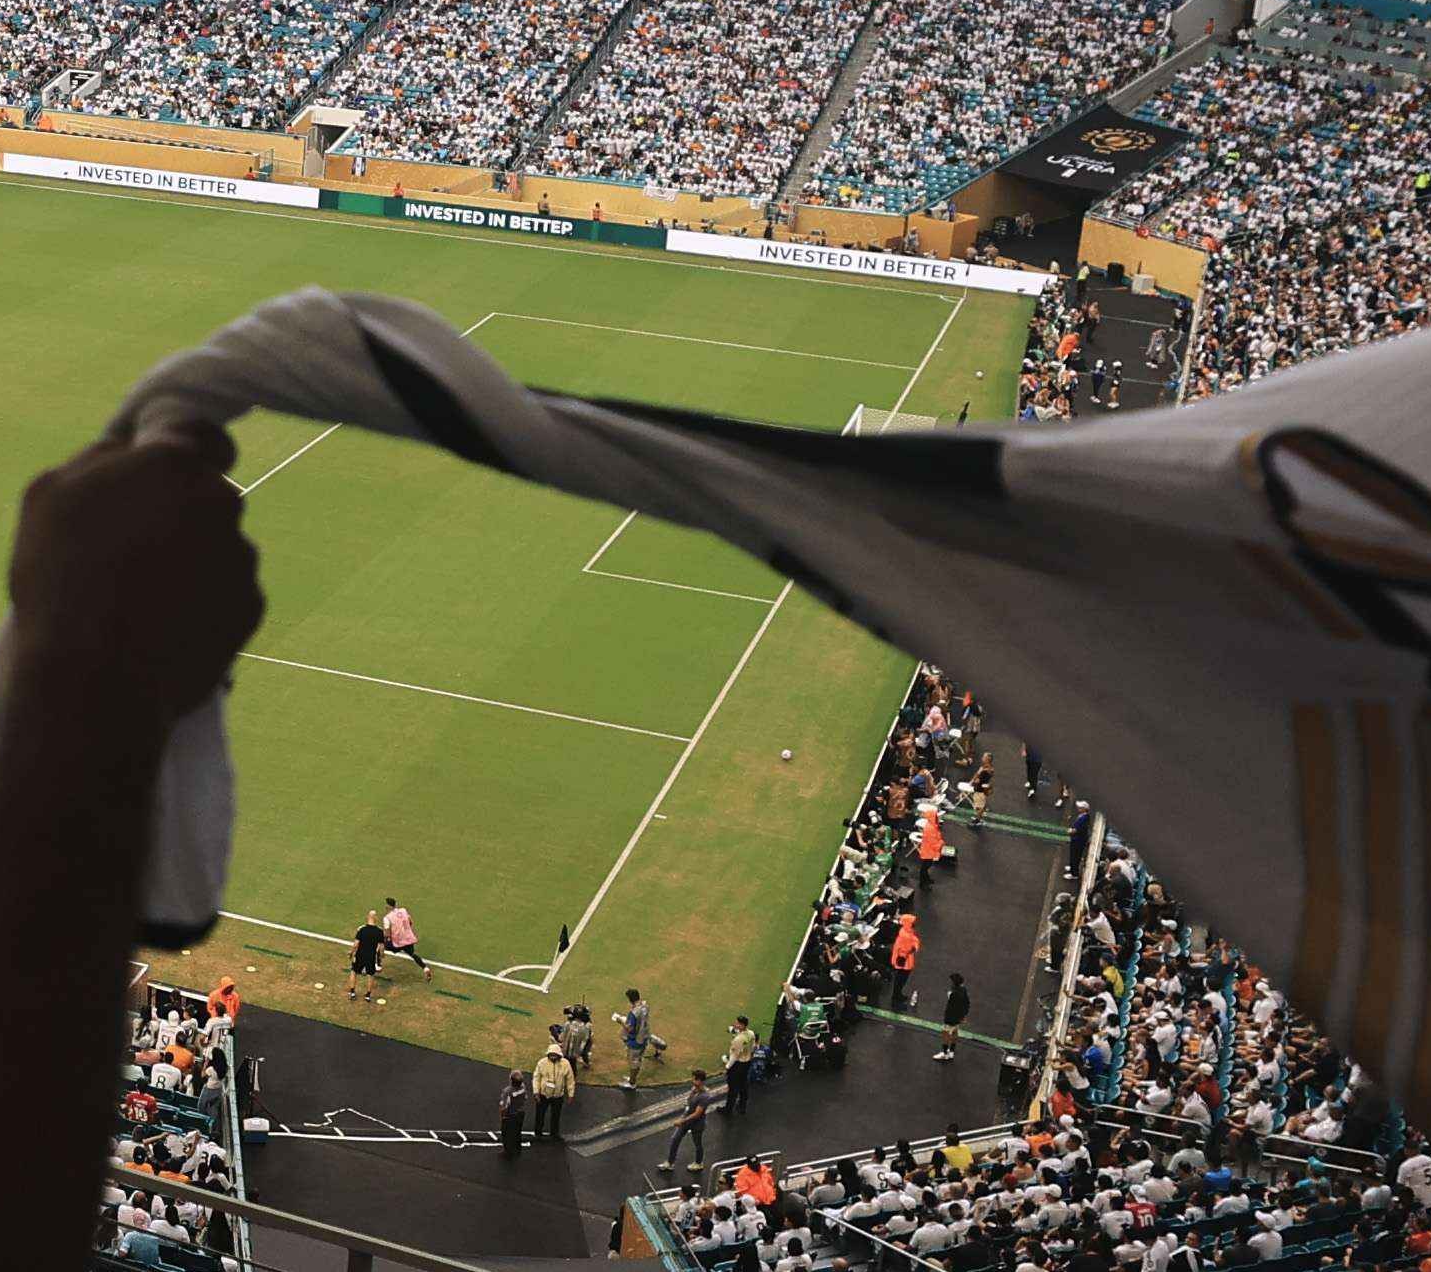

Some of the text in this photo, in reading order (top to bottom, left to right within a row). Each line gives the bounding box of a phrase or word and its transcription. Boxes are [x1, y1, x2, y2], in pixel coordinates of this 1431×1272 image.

[1046, 155, 1115, 174] ULTRA
[78, 165, 238, 195] INVESTED IN BETTER
[404, 203, 485, 225] INVESTED
[488, 212, 506, 227] IN
[759, 244, 956, 281] INVESTED IN BETTER
[1139, 1214, 1154, 1228] 10
